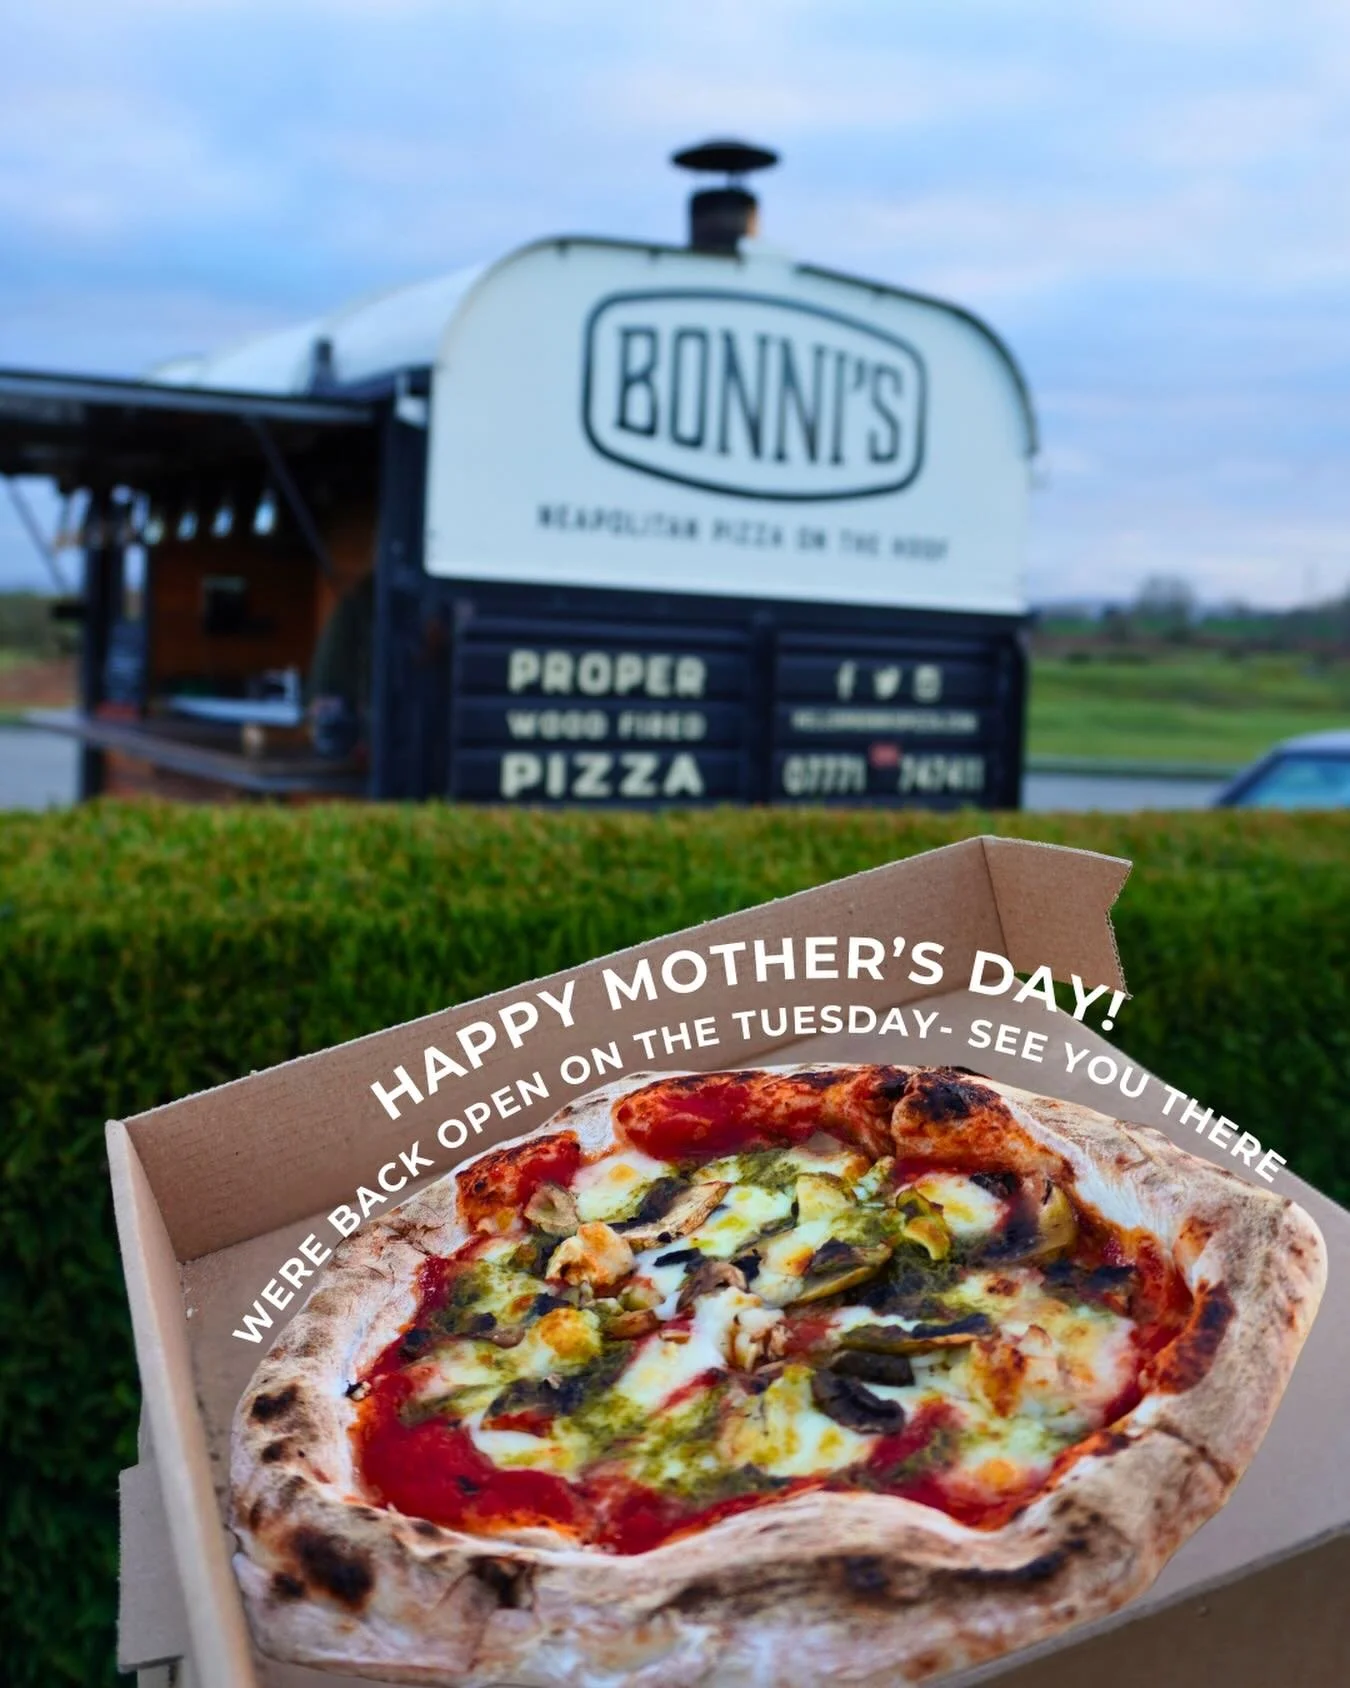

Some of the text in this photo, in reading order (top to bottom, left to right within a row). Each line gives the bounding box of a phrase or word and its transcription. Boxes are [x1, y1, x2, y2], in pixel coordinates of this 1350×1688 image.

[614, 325, 904, 466] BONNI'S
[536, 504, 699, 540] NEAPOLITAN
[712, 516, 783, 548] PIZZA
[797, 524, 827, 551] ON
[840, 526, 881, 556] THE
[508, 650, 707, 697] PROPER
[505, 710, 707, 741] WOOD FIRED
[502, 752, 704, 798] PIZZA
